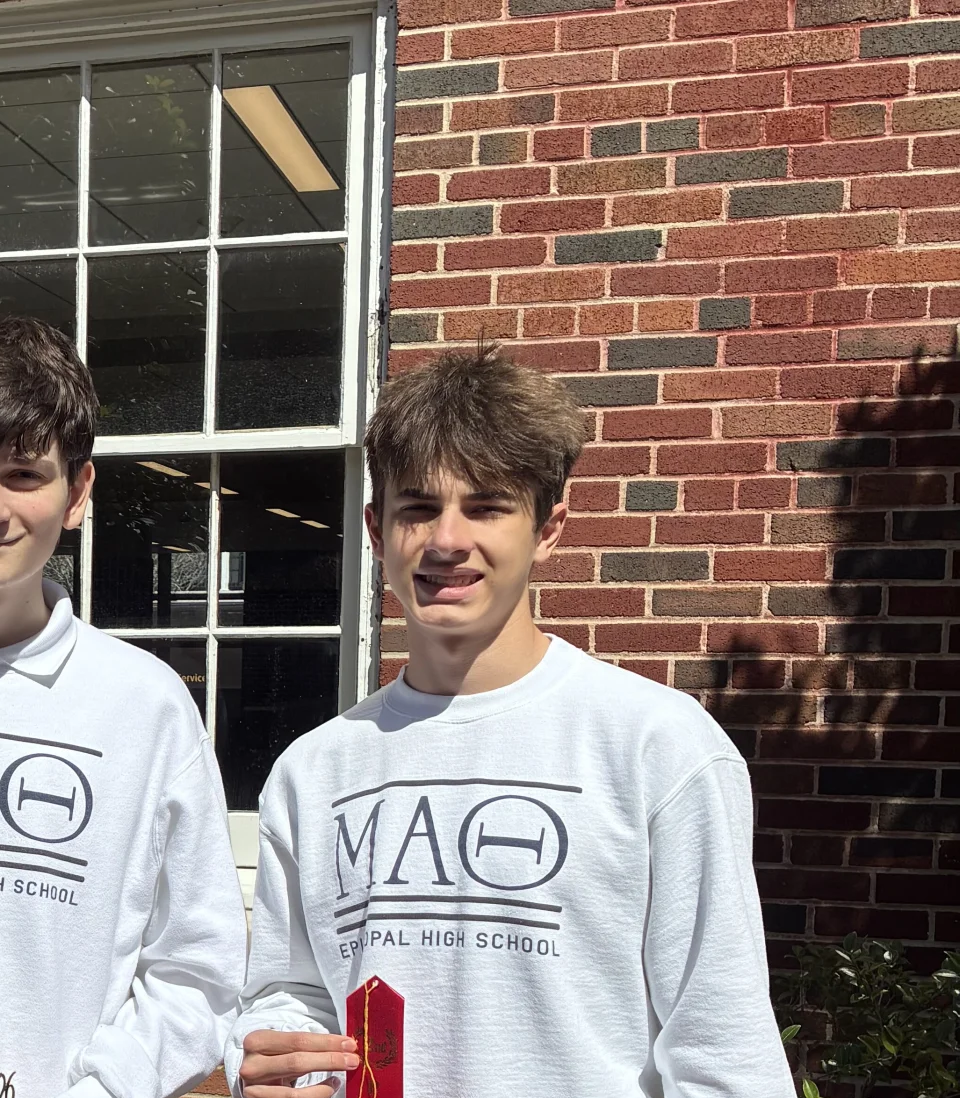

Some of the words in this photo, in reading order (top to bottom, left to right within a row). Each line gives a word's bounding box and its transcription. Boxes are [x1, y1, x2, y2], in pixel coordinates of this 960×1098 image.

[179, 673, 205, 683] ervice
[13, 879, 79, 907] SCHOOL
[421, 930, 465, 948] HIGH
[475, 931, 561, 958] SCHOOL
